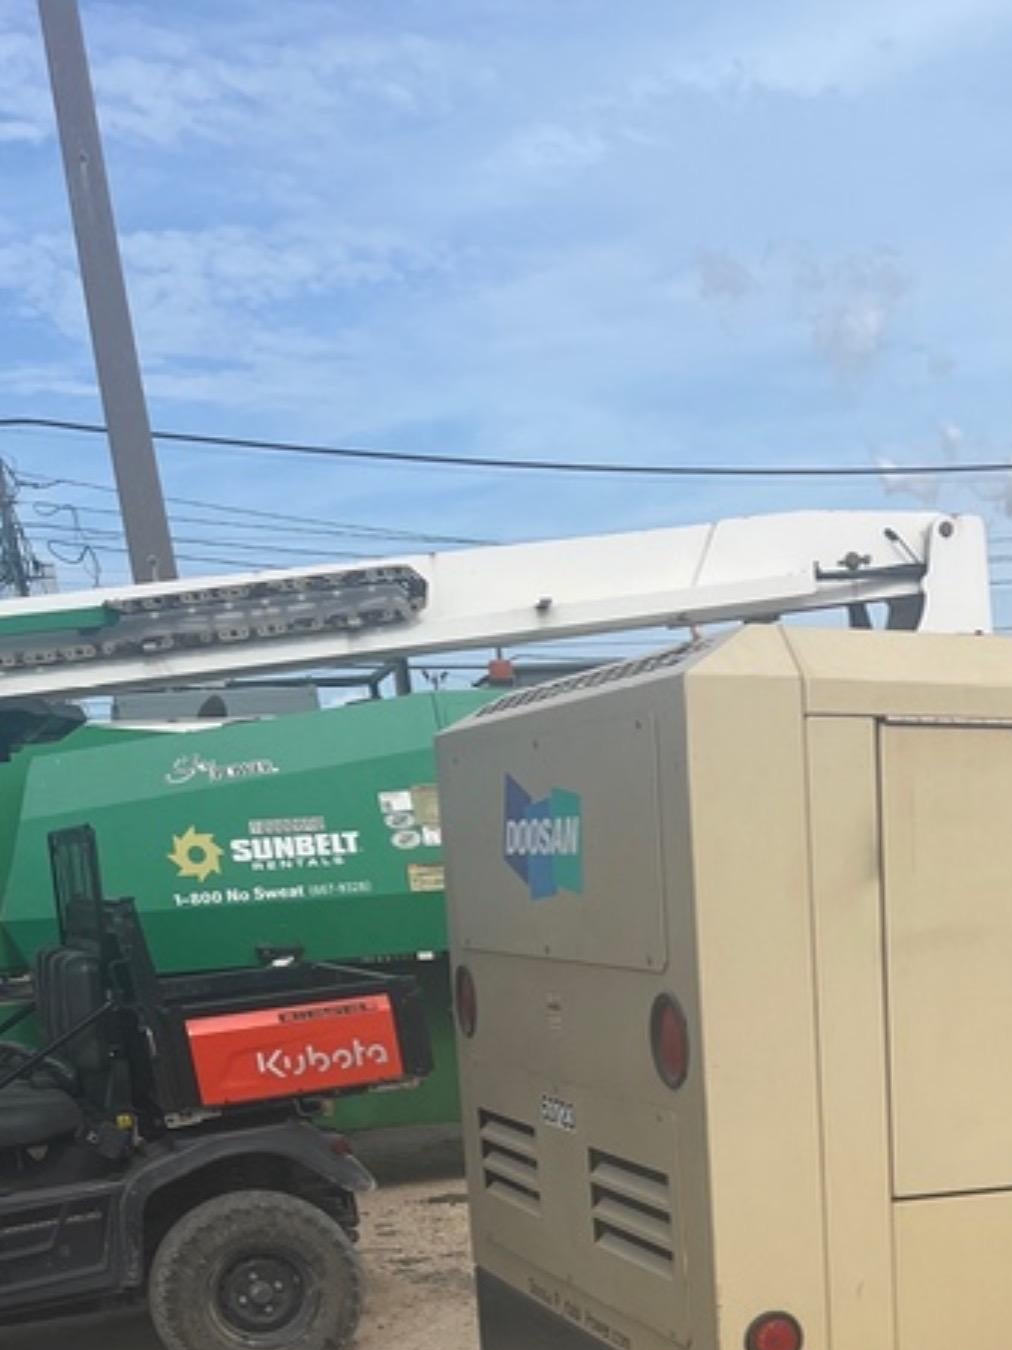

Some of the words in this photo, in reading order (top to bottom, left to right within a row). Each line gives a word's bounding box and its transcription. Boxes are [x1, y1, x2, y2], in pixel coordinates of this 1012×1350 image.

[230, 831, 359, 862] SUNBELT
[506, 816, 580, 856] DOOSAN
[251, 856, 346, 872] RENTALS
[173, 890, 223, 907] 1-800
[226, 888, 250, 903] No
[253, 885, 305, 901] Sweat
[256, 1038, 389, 1079] Kubota
